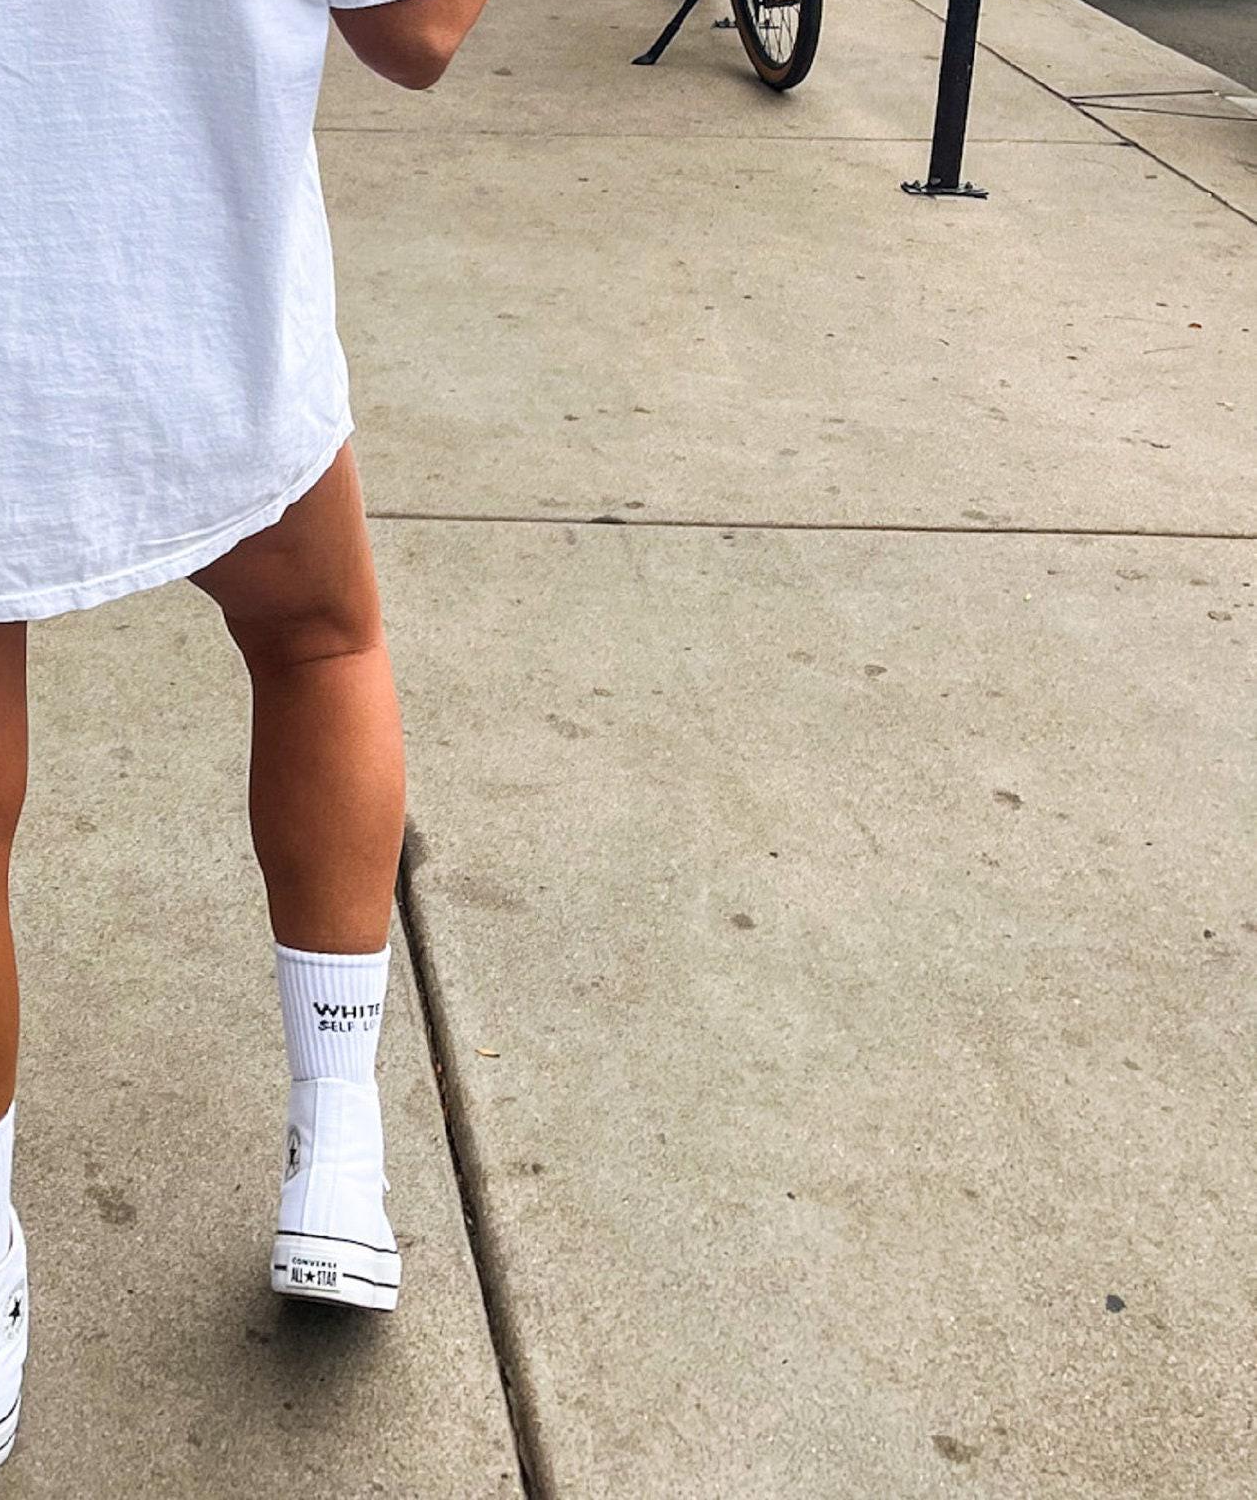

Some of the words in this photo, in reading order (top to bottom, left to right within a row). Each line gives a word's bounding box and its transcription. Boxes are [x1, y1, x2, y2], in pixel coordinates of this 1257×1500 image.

[313, 1002, 380, 1019] WHITE
[291, 1267, 303, 1284] ALL
[317, 1270, 337, 1287] STAR
